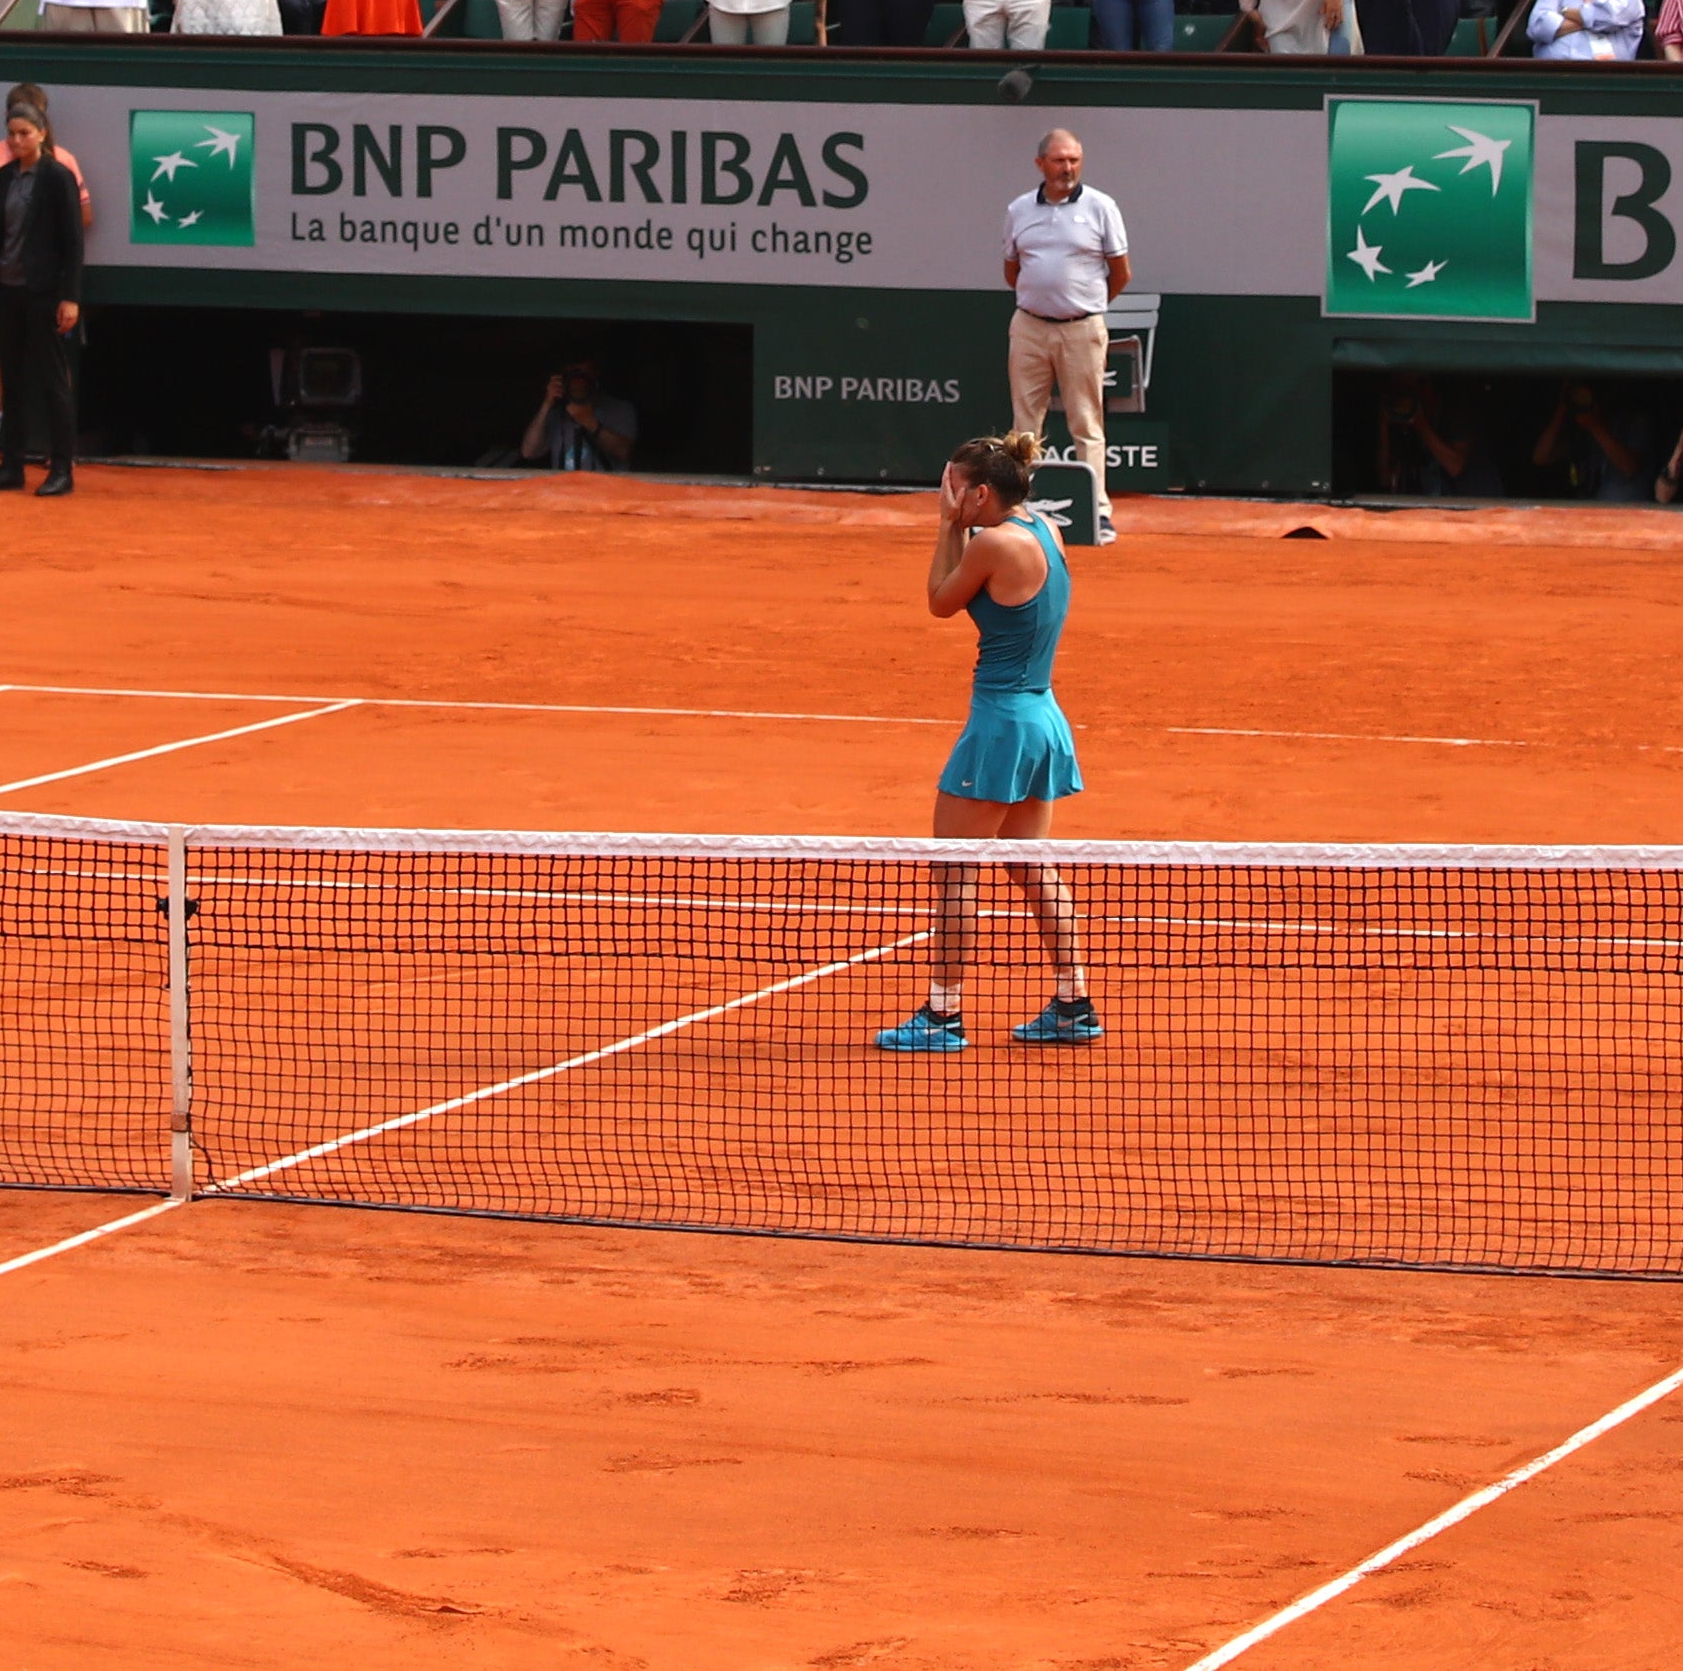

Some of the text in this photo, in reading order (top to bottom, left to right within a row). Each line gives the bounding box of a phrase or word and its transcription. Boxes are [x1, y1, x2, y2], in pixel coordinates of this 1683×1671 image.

[290, 122, 870, 210] BNP PARIBAS
[291, 211, 874, 265] La banque d'un monde qui change
[774, 375, 961, 404] BNP PARIBAS
